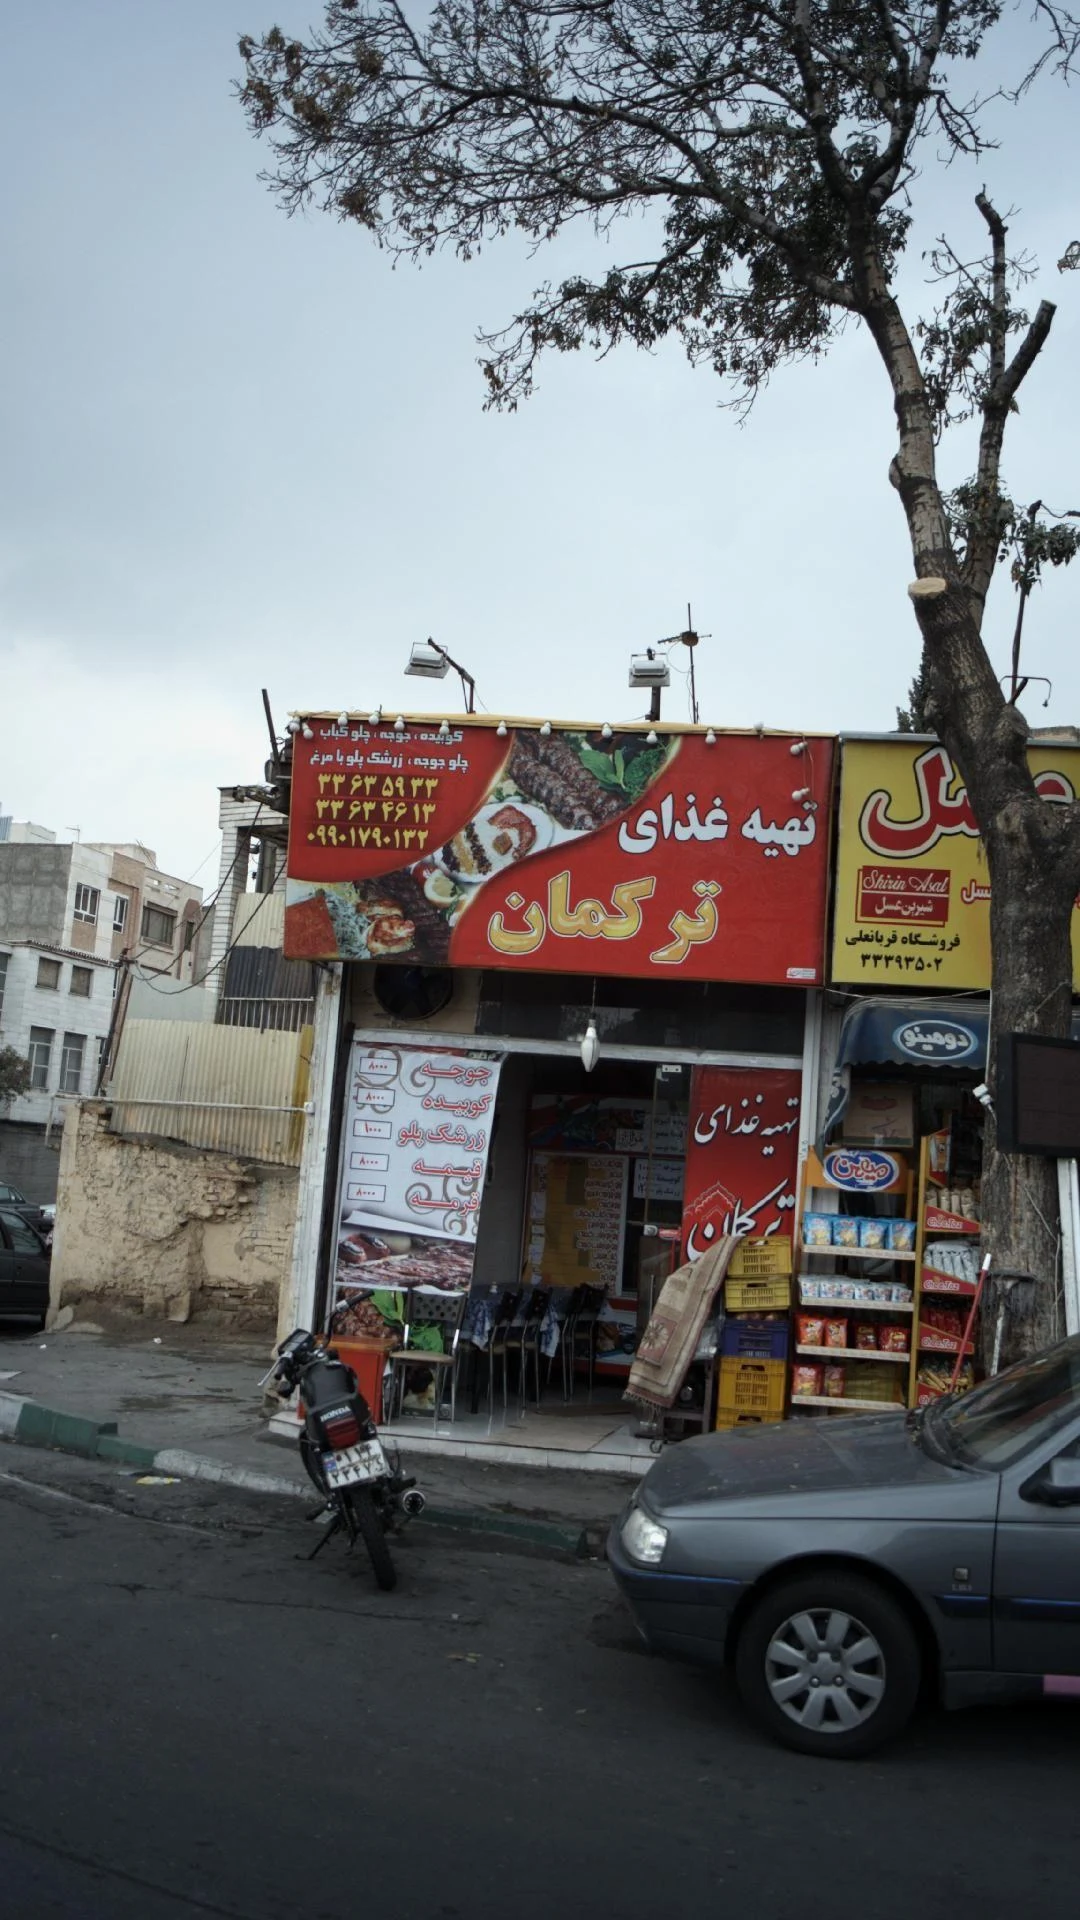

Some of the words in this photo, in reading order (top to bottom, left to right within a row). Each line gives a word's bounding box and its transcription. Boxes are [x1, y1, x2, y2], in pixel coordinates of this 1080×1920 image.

[320, 723, 349, 740] کباب
[351, 725, 371, 743] چلو
[310, 750, 333, 765] مرغ
[336, 749, 344, 766] با
[346, 749, 364, 768] پلو
[366, 750, 403, 768] زرشک
[449, 753, 469, 773] چلو
[617, 792, 730, 854] غذای
[740, 799, 819, 857] تهیه
[863, 869, 907, 891] Shirin
[908, 872, 950, 894] Asal
[874, 896, 902, 915] عسل
[845, 929, 898, 948] قربانعلی
[901, 932, 961, 951] فروشگاه
[860, 953, 943, 972] ۳۳۳۹۳۵۰۲
[903, 1026, 970, 1051] دومینو
[420, 1061, 492, 1086] جوجه
[422, 1095, 493, 1119] کوبیده
[694, 1094, 763, 1144] غذای
[760, 1096, 799, 1155] تهیه
[397, 1121, 424, 1147] پلو
[427, 1123, 486, 1151] زرشک
[412, 1158, 483, 1183] قیمه
[410, 1191, 480, 1216] قرمه
[320, 1405, 351, 1422] HONDA
